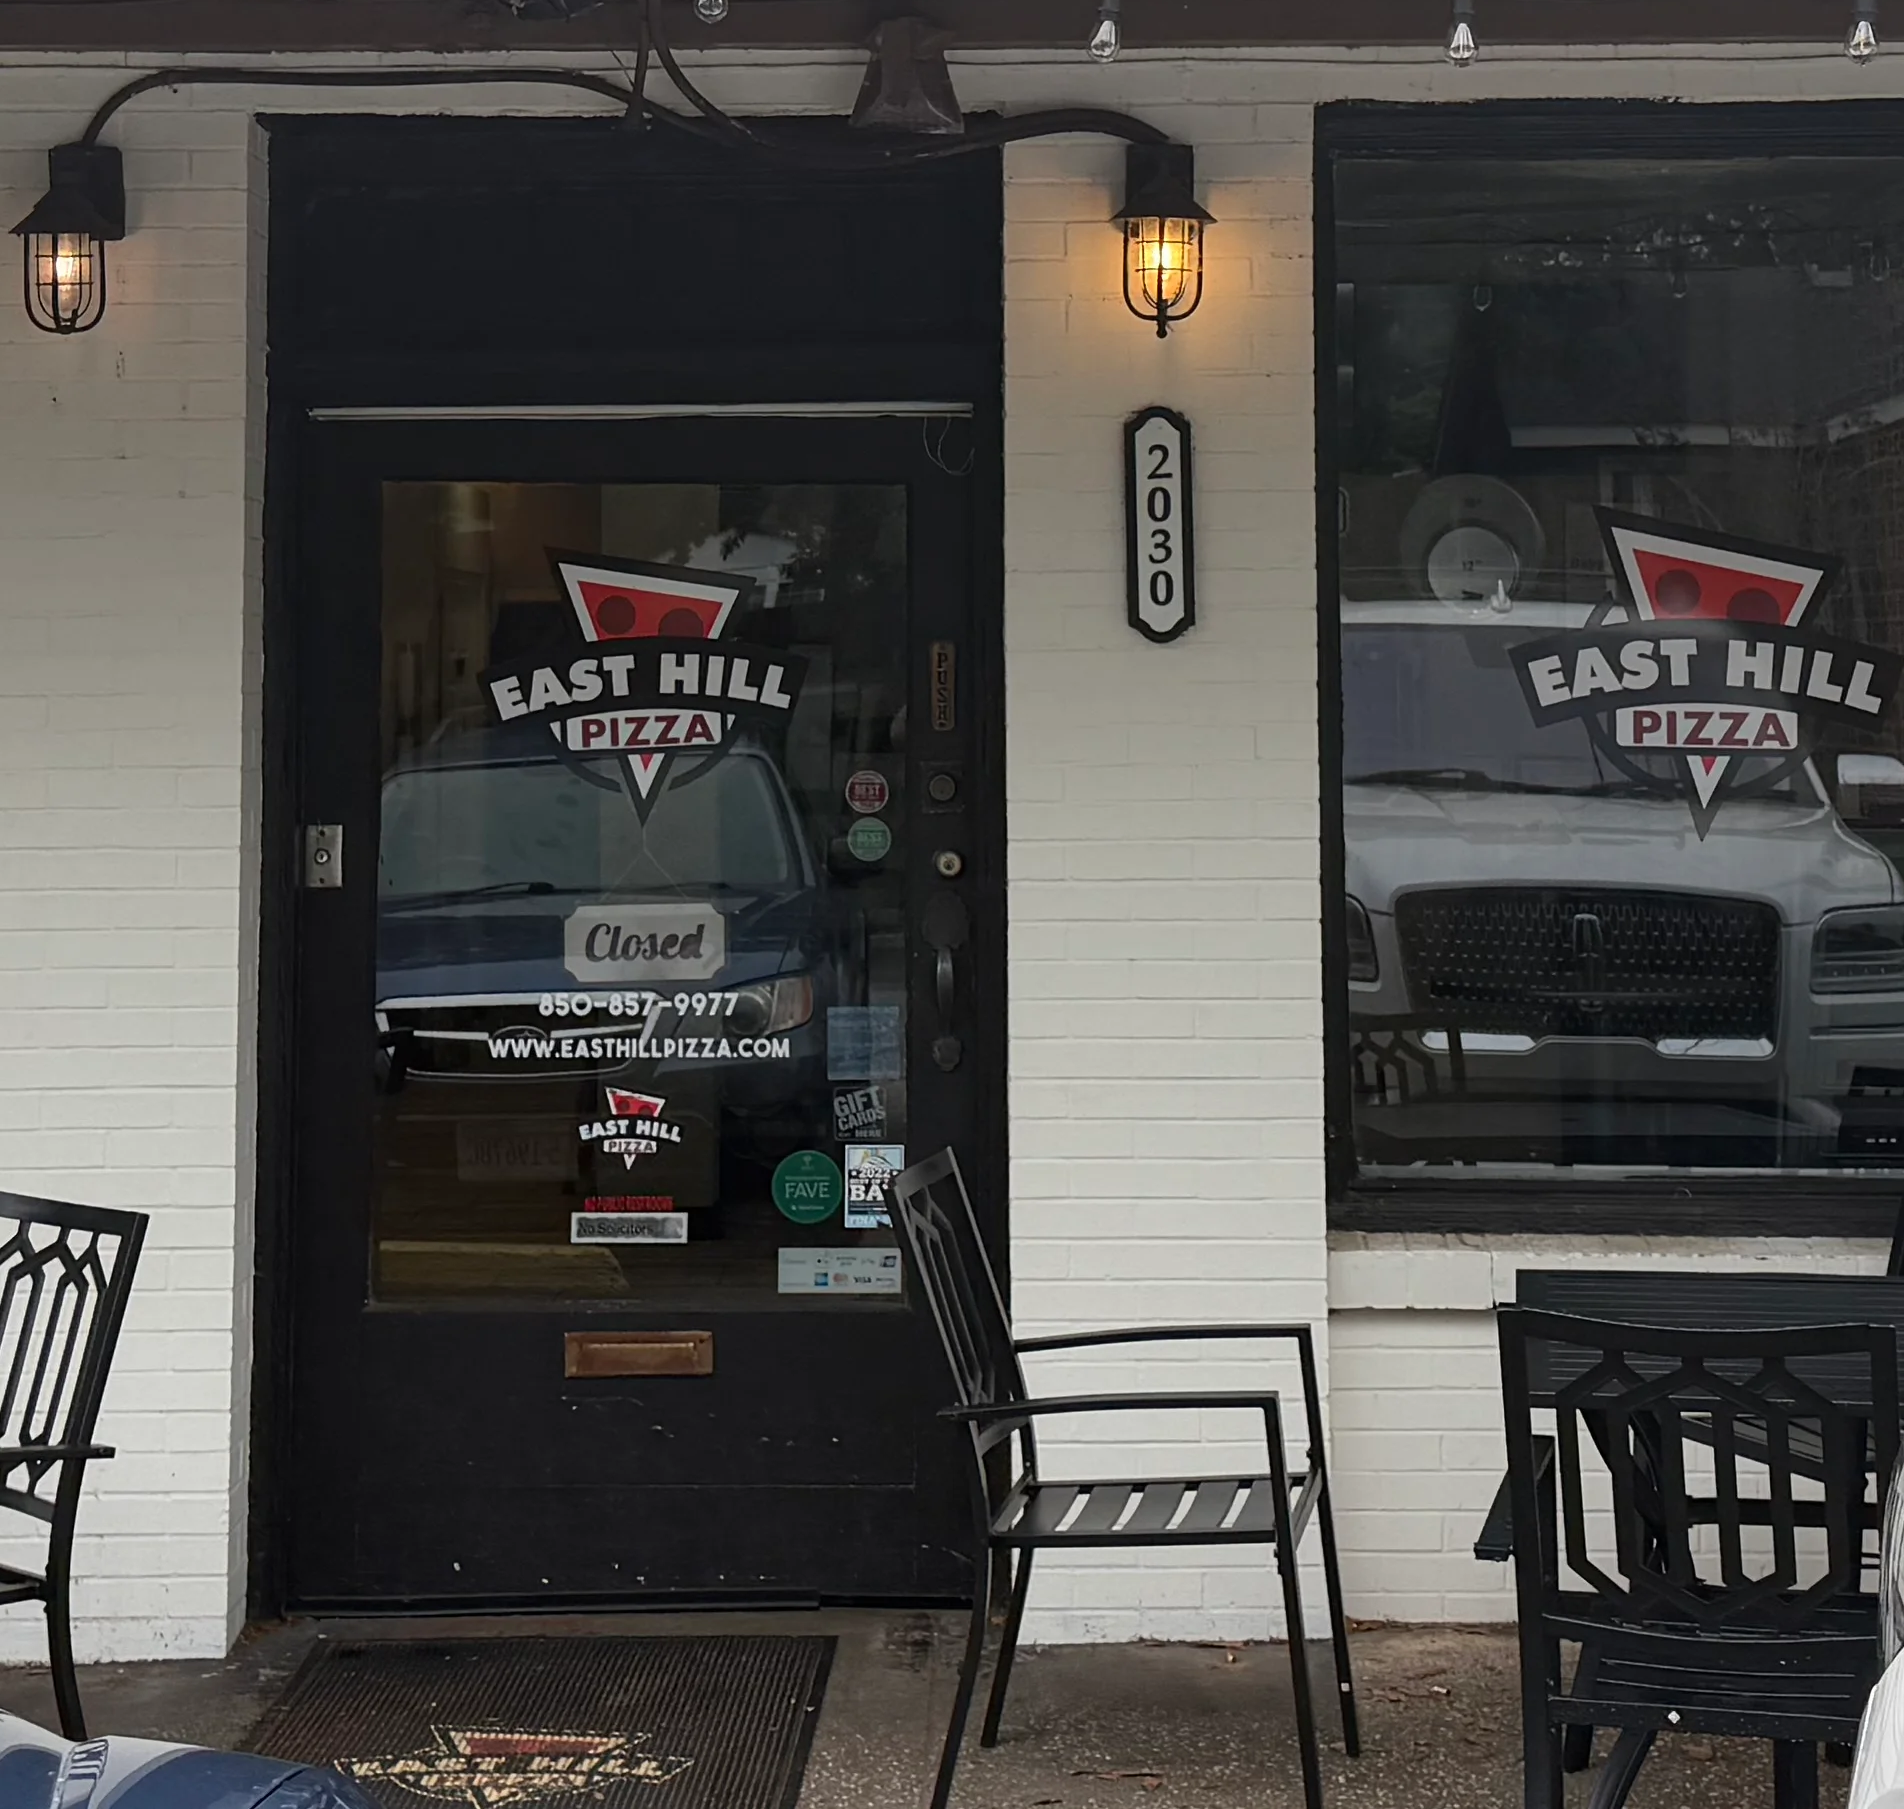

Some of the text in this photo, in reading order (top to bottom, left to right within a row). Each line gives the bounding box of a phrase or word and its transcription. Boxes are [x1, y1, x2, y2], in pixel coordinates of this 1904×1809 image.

[1147, 444, 1174, 606] 2030
[490, 653, 792, 722] EAST HILL
[937, 652, 948, 721] PUSH
[1527, 638, 1882, 714] EAST HILL
[581, 715, 715, 748] PIZZA
[1632, 711, 1790, 746] PIZZA
[585, 923, 705, 962] Closed
[539, 992, 739, 1016] 850-857-9977
[488, 1038, 790, 1058] WWW.EASTHILLPIZZA.COM
[834, 1086, 879, 1117] GIFT
[579, 1120, 681, 1142] EAST HILL
[838, 1106, 886, 1130] CARDS
[609, 1142, 653, 1152] PIZZA
[859, 1168, 891, 1178] 2022
[785, 1182, 830, 1198] FAVE
[850, 1184, 888, 1201] BA
